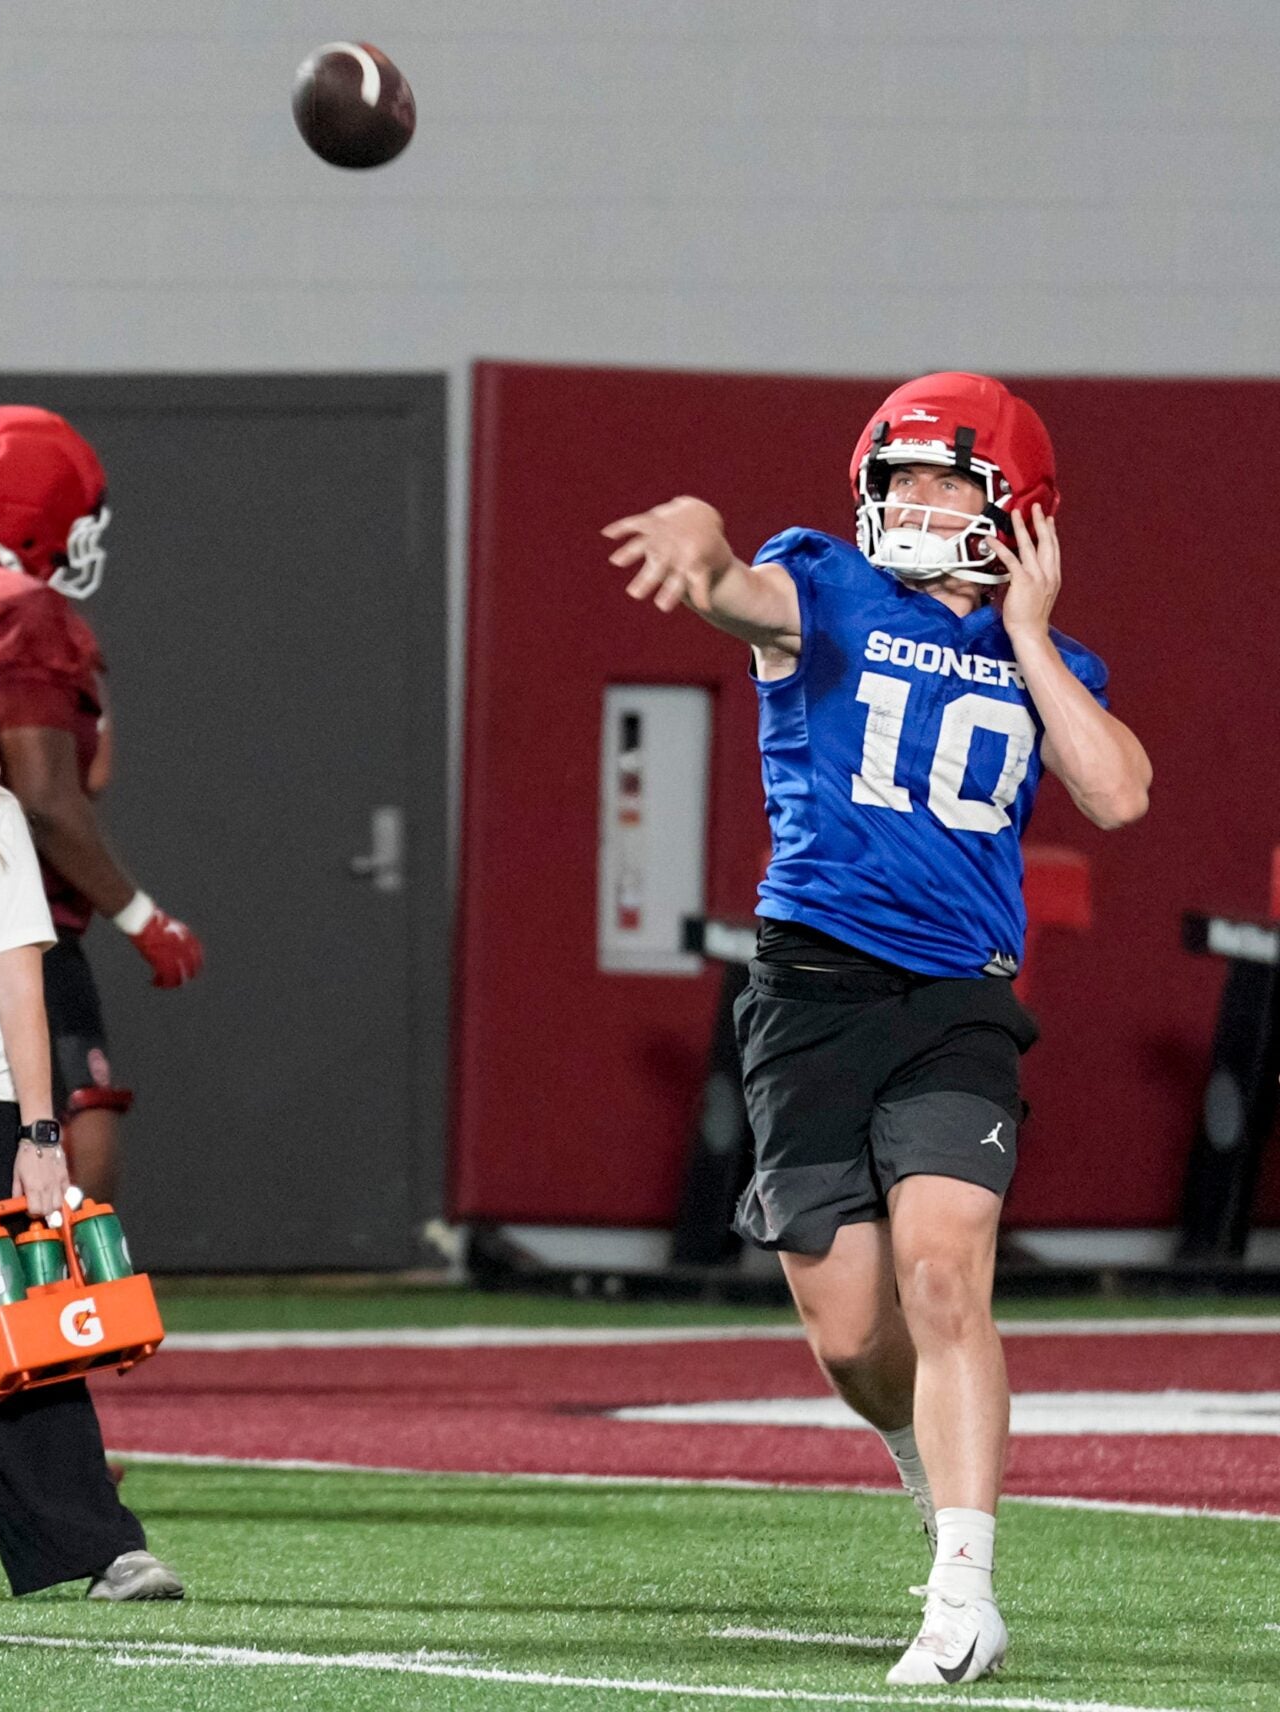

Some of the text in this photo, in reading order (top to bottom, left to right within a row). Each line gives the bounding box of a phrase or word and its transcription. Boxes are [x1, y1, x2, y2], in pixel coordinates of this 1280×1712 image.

[864, 630, 1026, 690] SOONER
[851, 670, 1038, 835] 10
[59, 1296, 105, 1348] G
